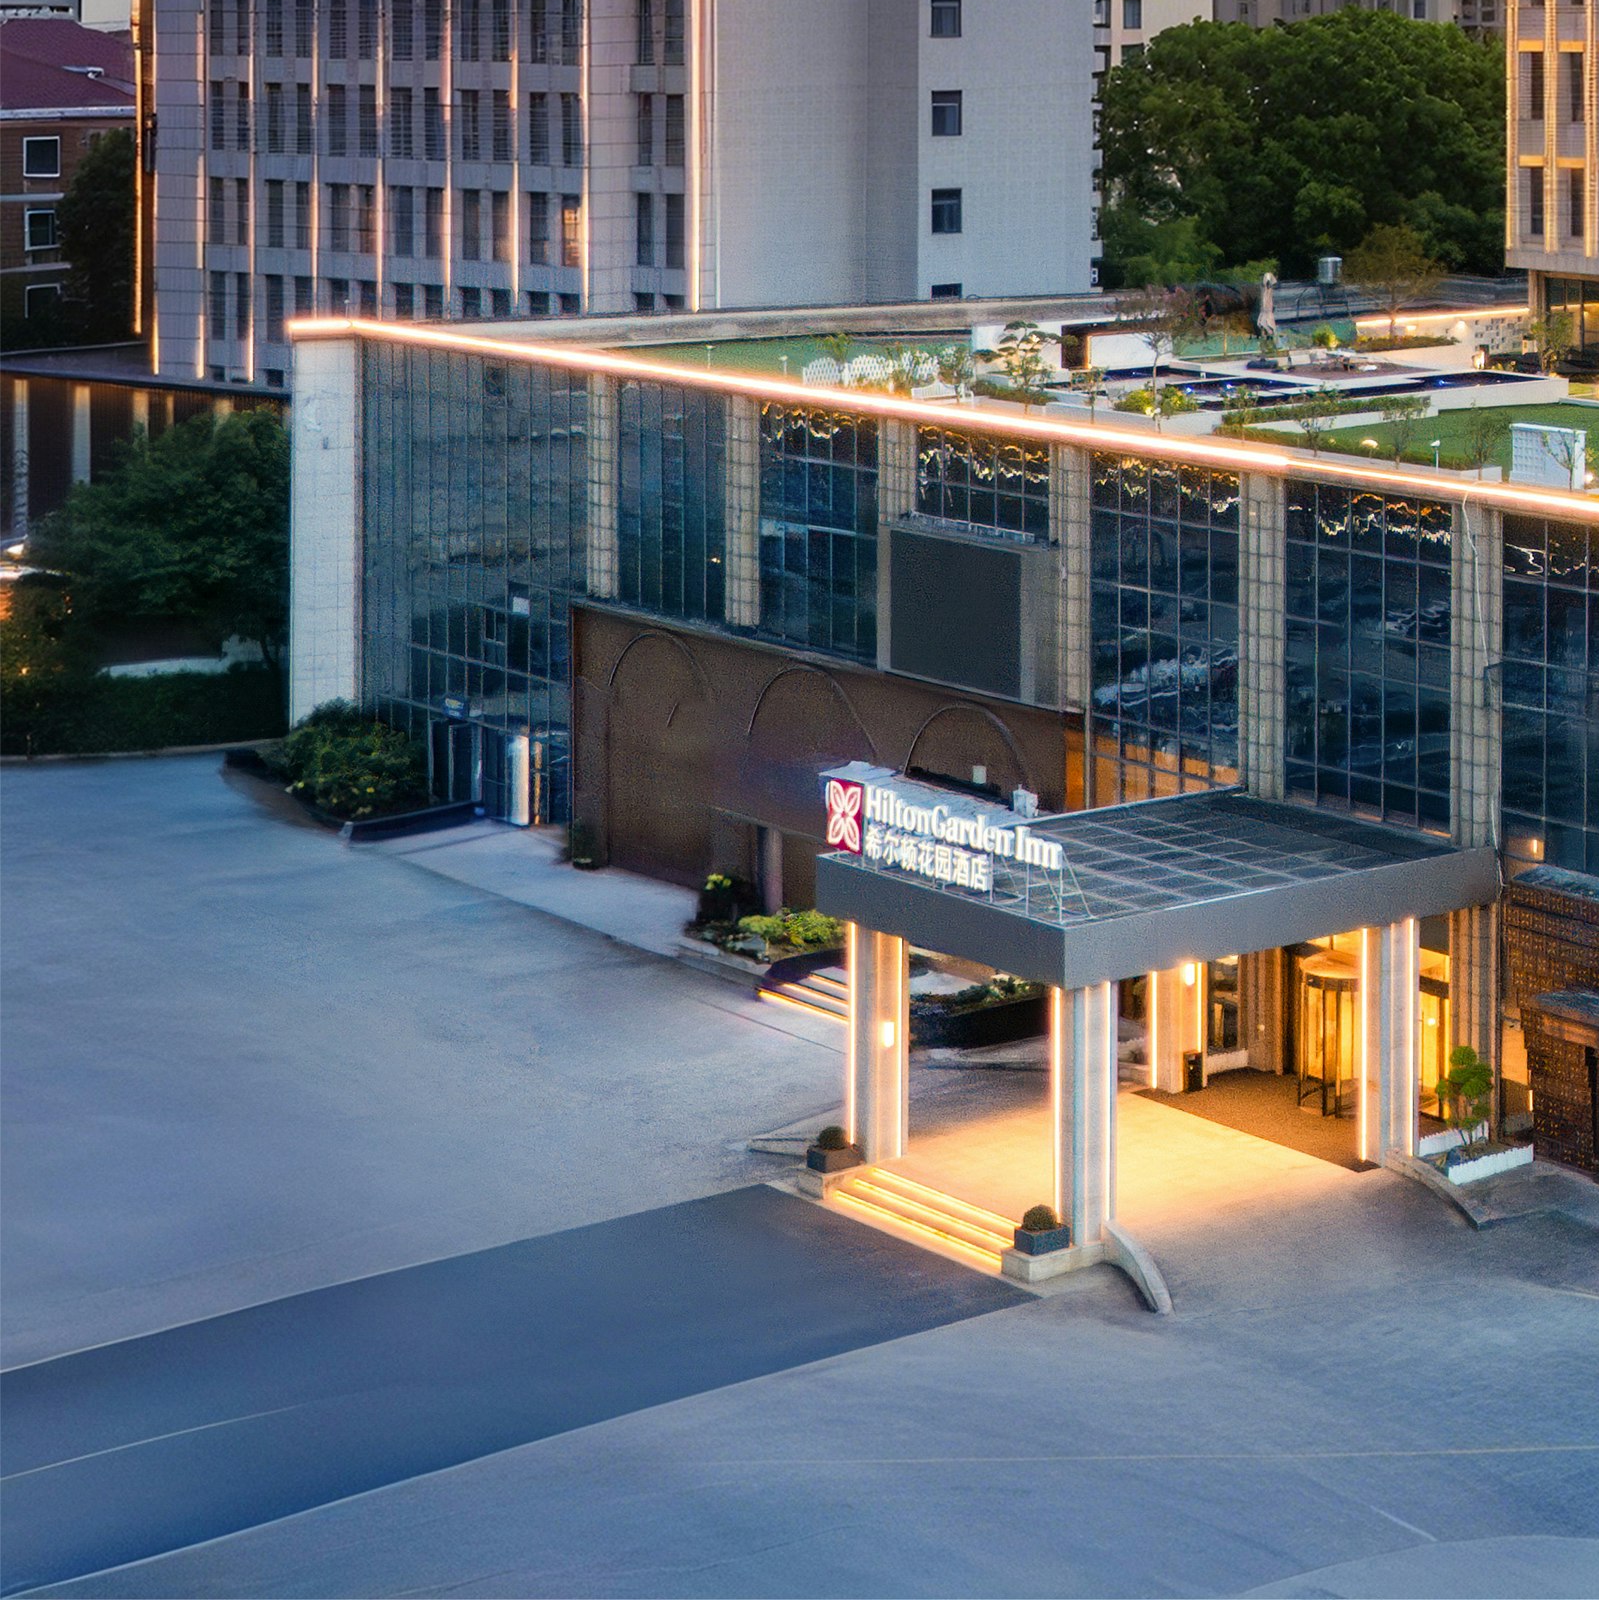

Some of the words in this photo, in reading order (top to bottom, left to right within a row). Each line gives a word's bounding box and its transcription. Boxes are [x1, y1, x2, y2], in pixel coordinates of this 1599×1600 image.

[865, 785, 929, 836] Hilton
[929, 804, 1015, 857] Garden
[1015, 826, 1063, 870] Inn
[865, 826, 992, 892] 希尔顿花园酒店
